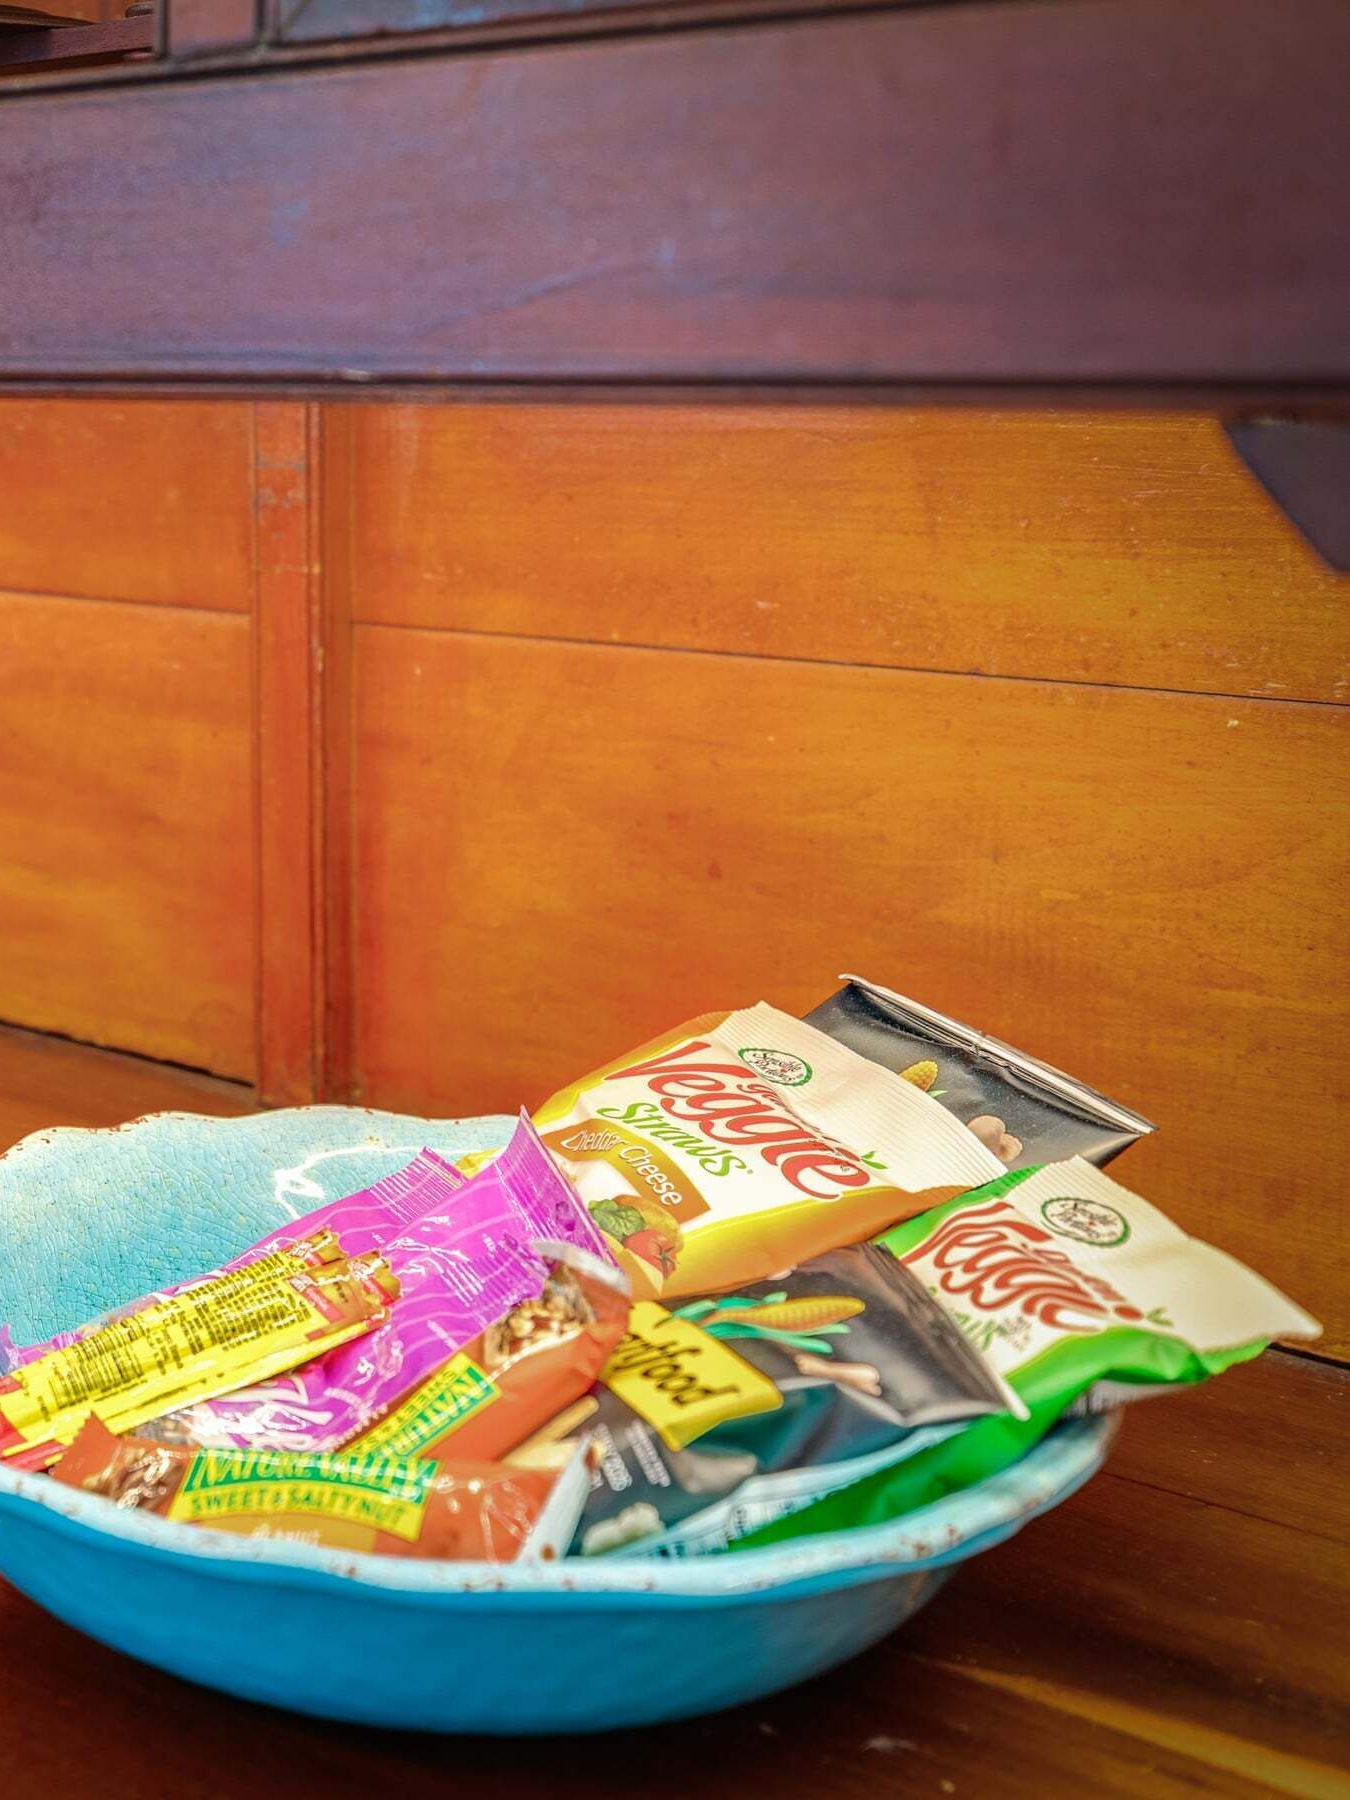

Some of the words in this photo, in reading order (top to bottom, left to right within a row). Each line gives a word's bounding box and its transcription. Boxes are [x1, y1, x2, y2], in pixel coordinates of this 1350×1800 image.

[596, 1102, 748, 1177] Straws
[604, 1040, 871, 1200] Veggie
[618, 1145, 683, 1206] Cheese
[191, 1447, 314, 1490] NATURE
[192, 1487, 269, 1513] SWEET
[361, 1494, 407, 1525] NUT
